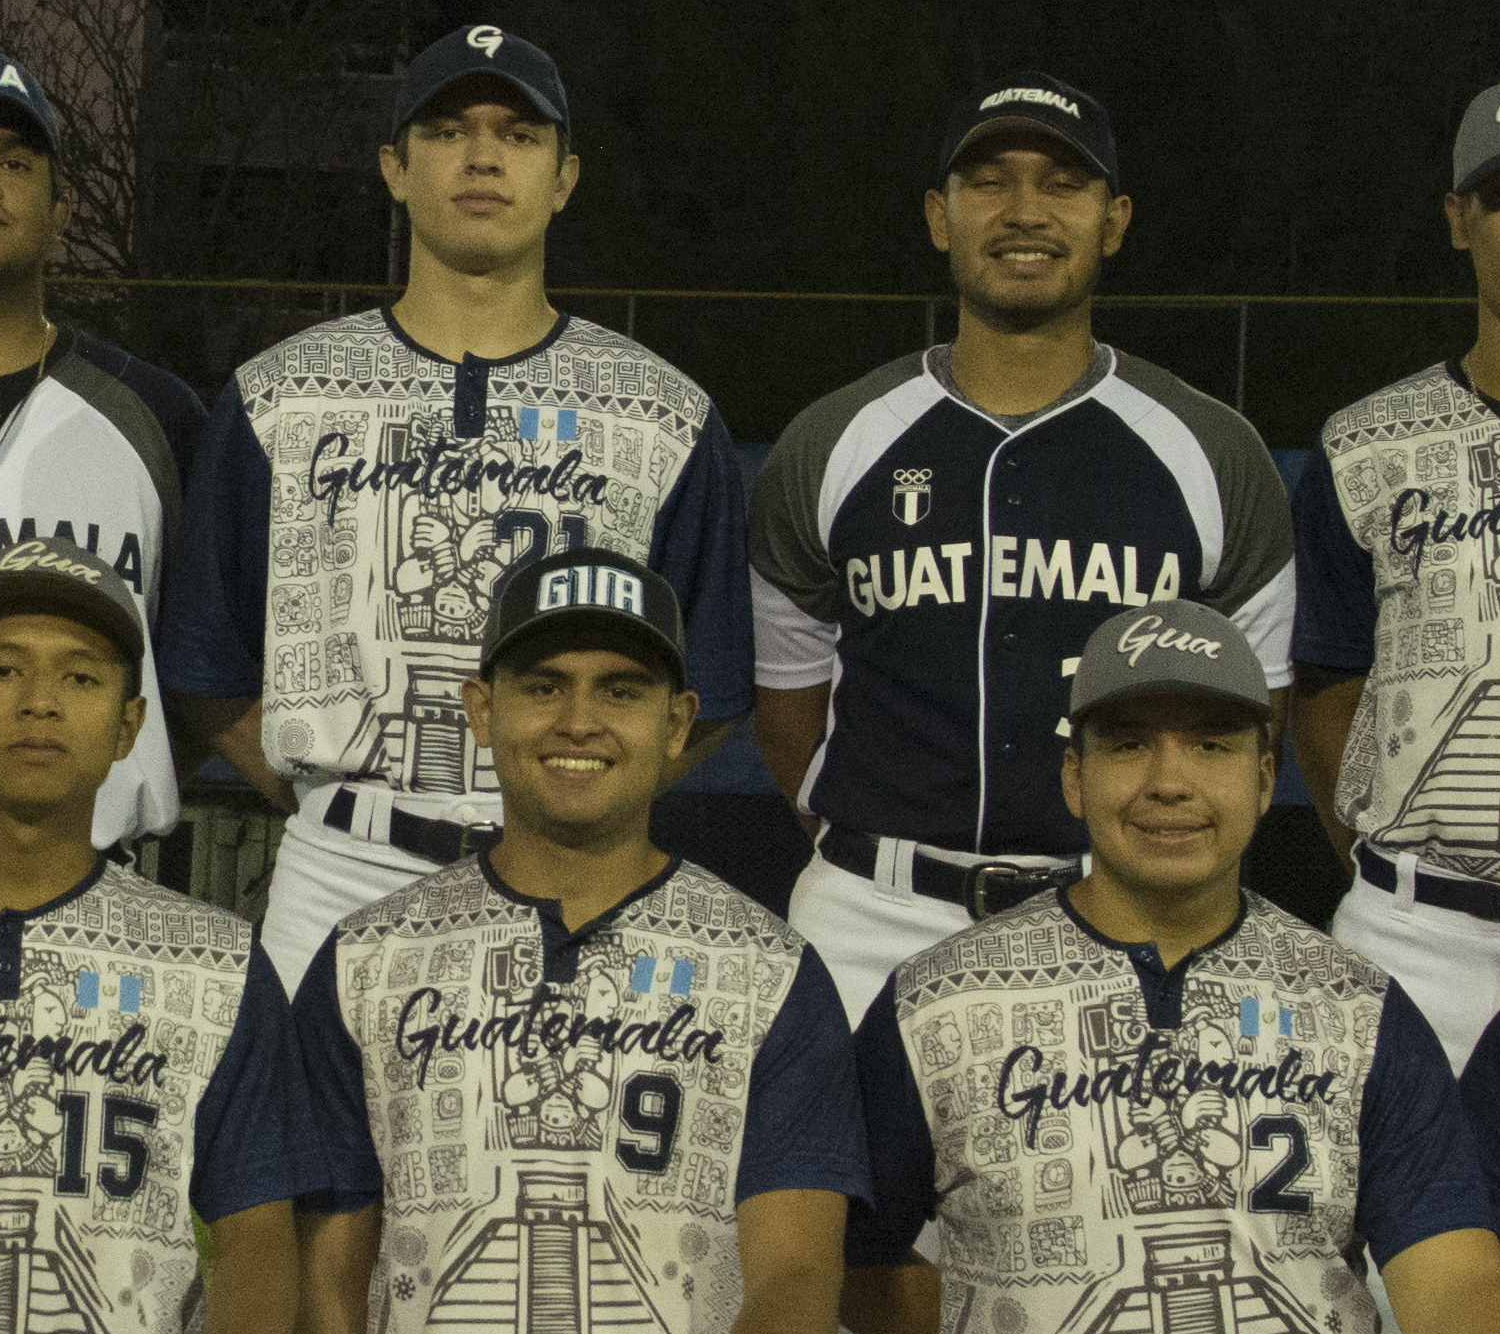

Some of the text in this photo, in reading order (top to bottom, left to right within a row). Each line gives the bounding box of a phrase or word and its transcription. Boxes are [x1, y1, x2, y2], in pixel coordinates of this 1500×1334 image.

[308, 433, 607, 525] Guatemala
[0, 540, 101, 585] Gua
[535, 565, 645, 618] GUA
[1116, 614, 1221, 668] Gua
[398, 986, 725, 1090] Guatemala
[52, 1088, 160, 1199] 15
[614, 1069, 686, 1178] 9
[998, 1044, 1339, 1148] Guatemala
[1246, 1112, 1315, 1215] 2
